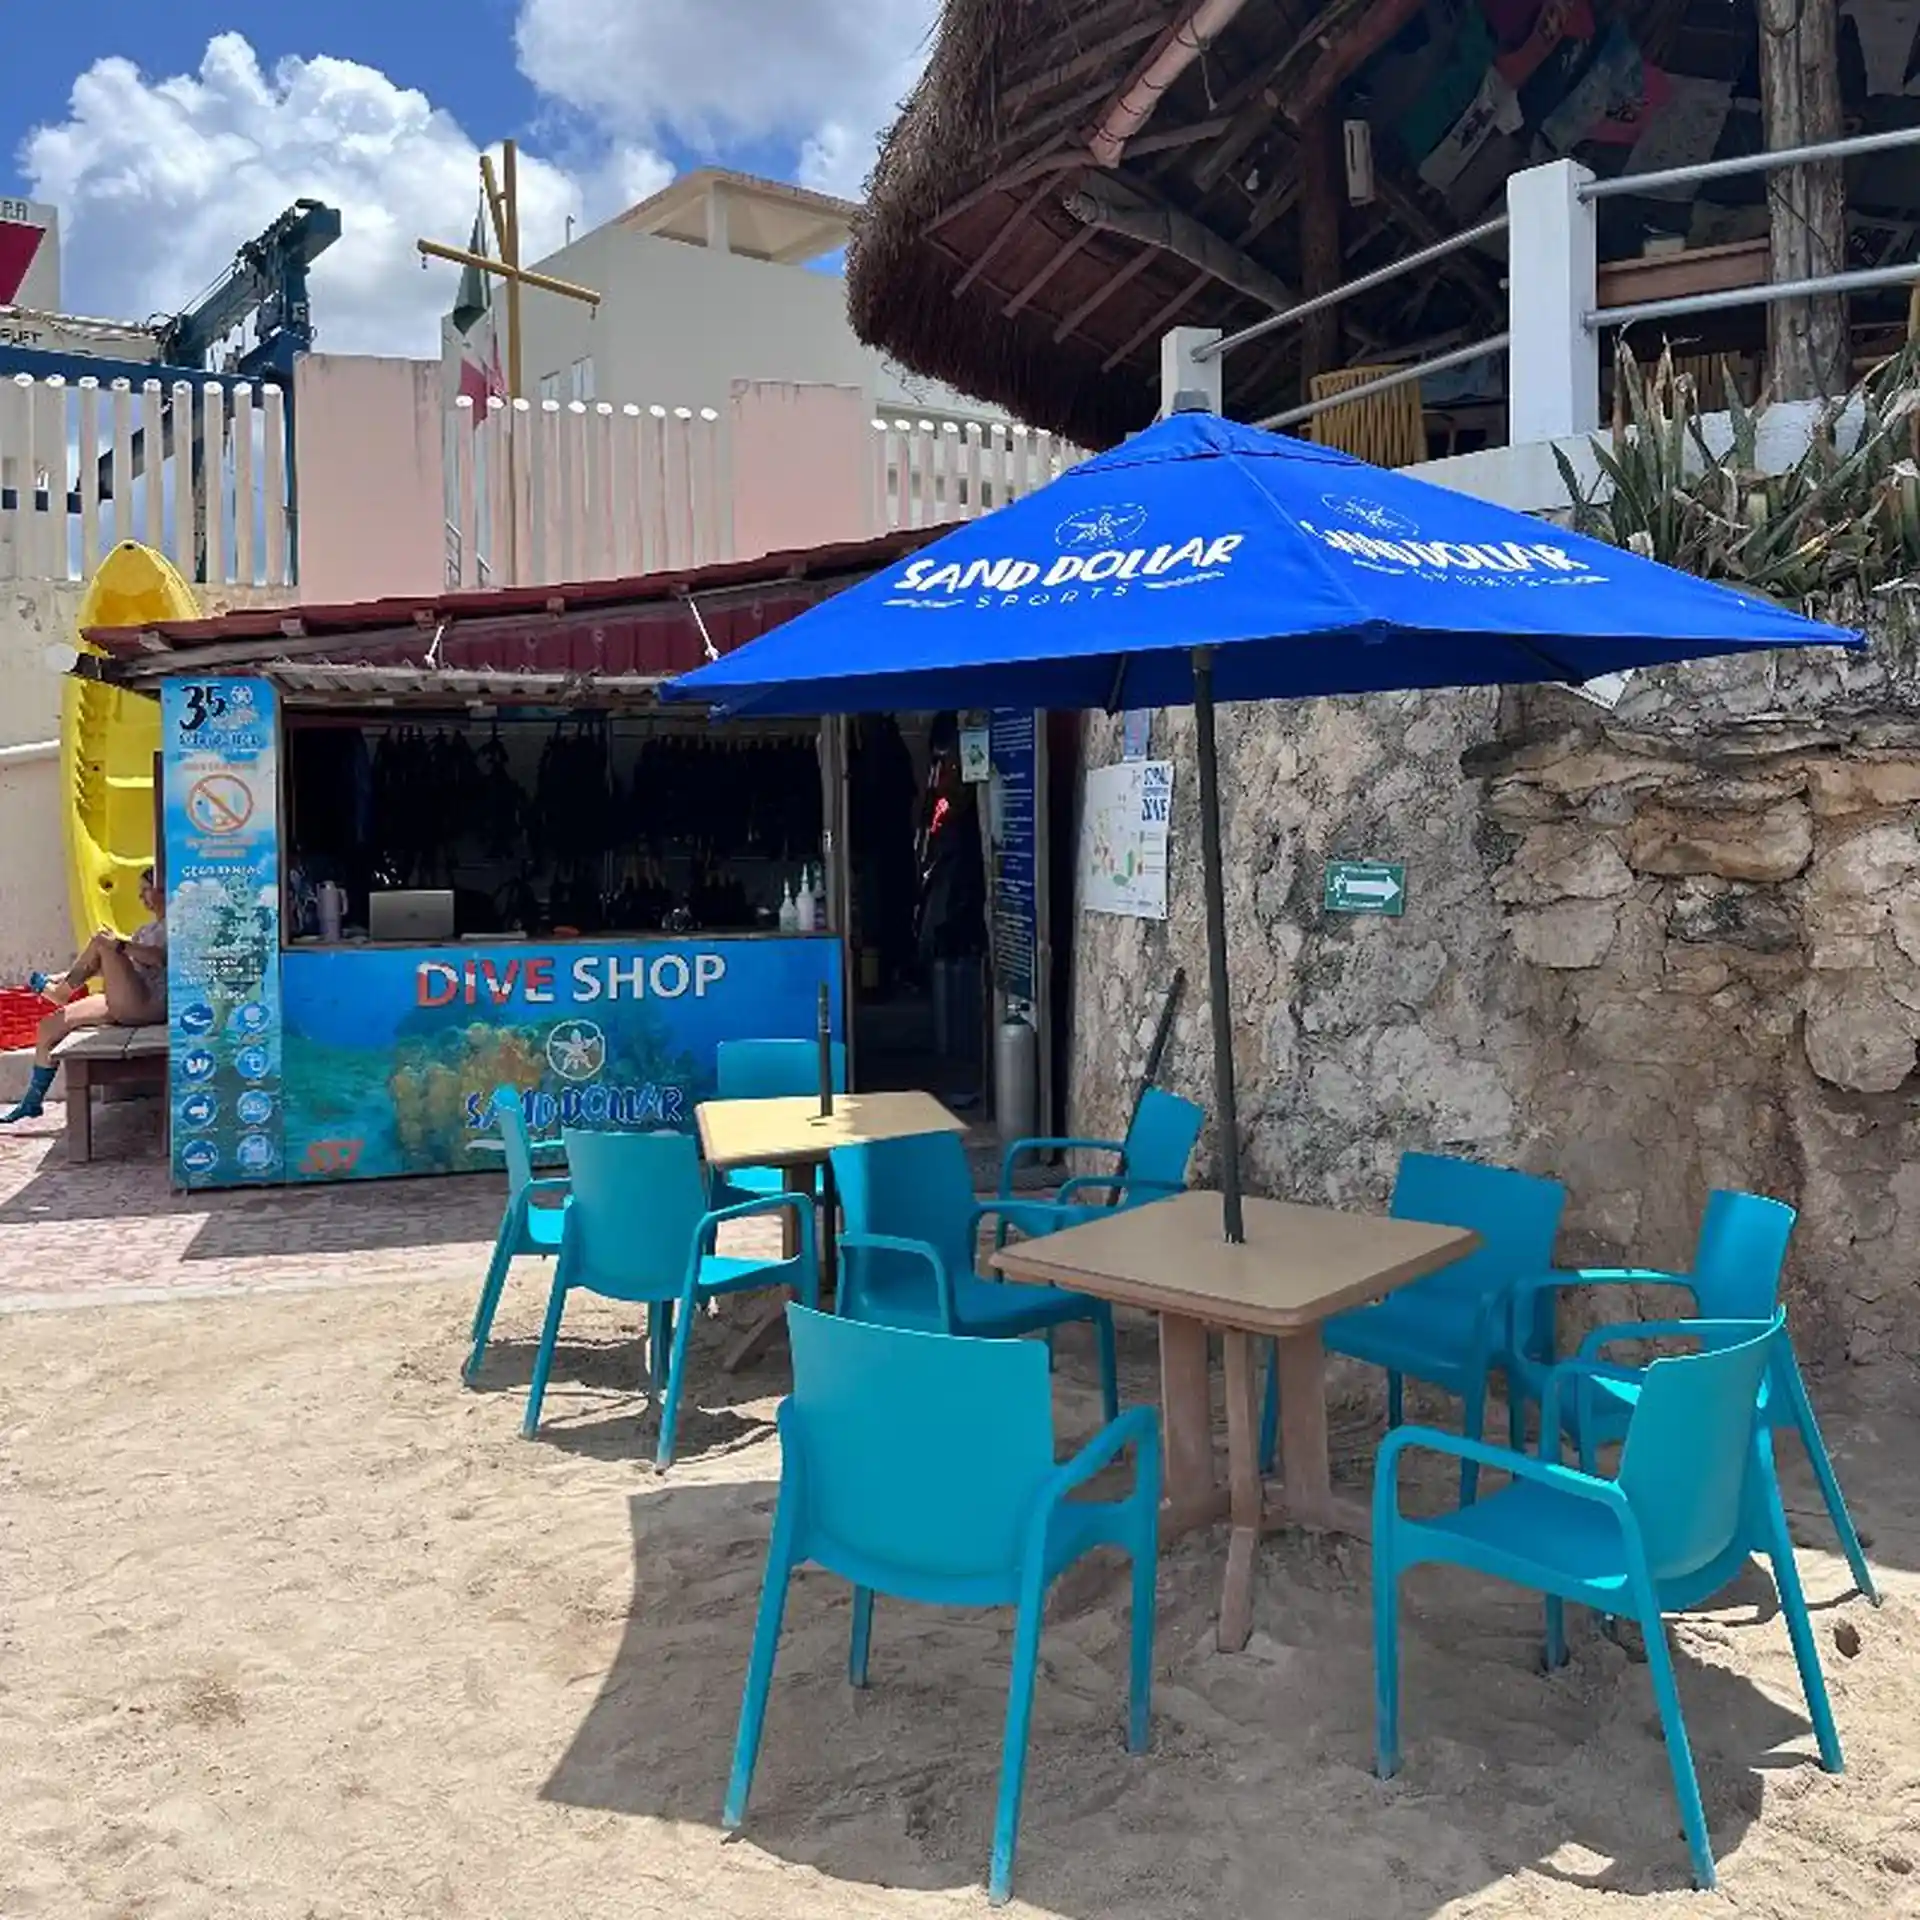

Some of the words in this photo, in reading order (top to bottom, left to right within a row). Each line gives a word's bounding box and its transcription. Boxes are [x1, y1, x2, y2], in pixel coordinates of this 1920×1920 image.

[894, 557, 1041, 593] SAND
[1042, 533, 1244, 586] DOLLAR
[975, 583, 1130, 608] SPORTS
[179, 685, 227, 731] 35
[415, 958, 556, 1007] DIVE
[572, 953, 727, 1003] SHOP
